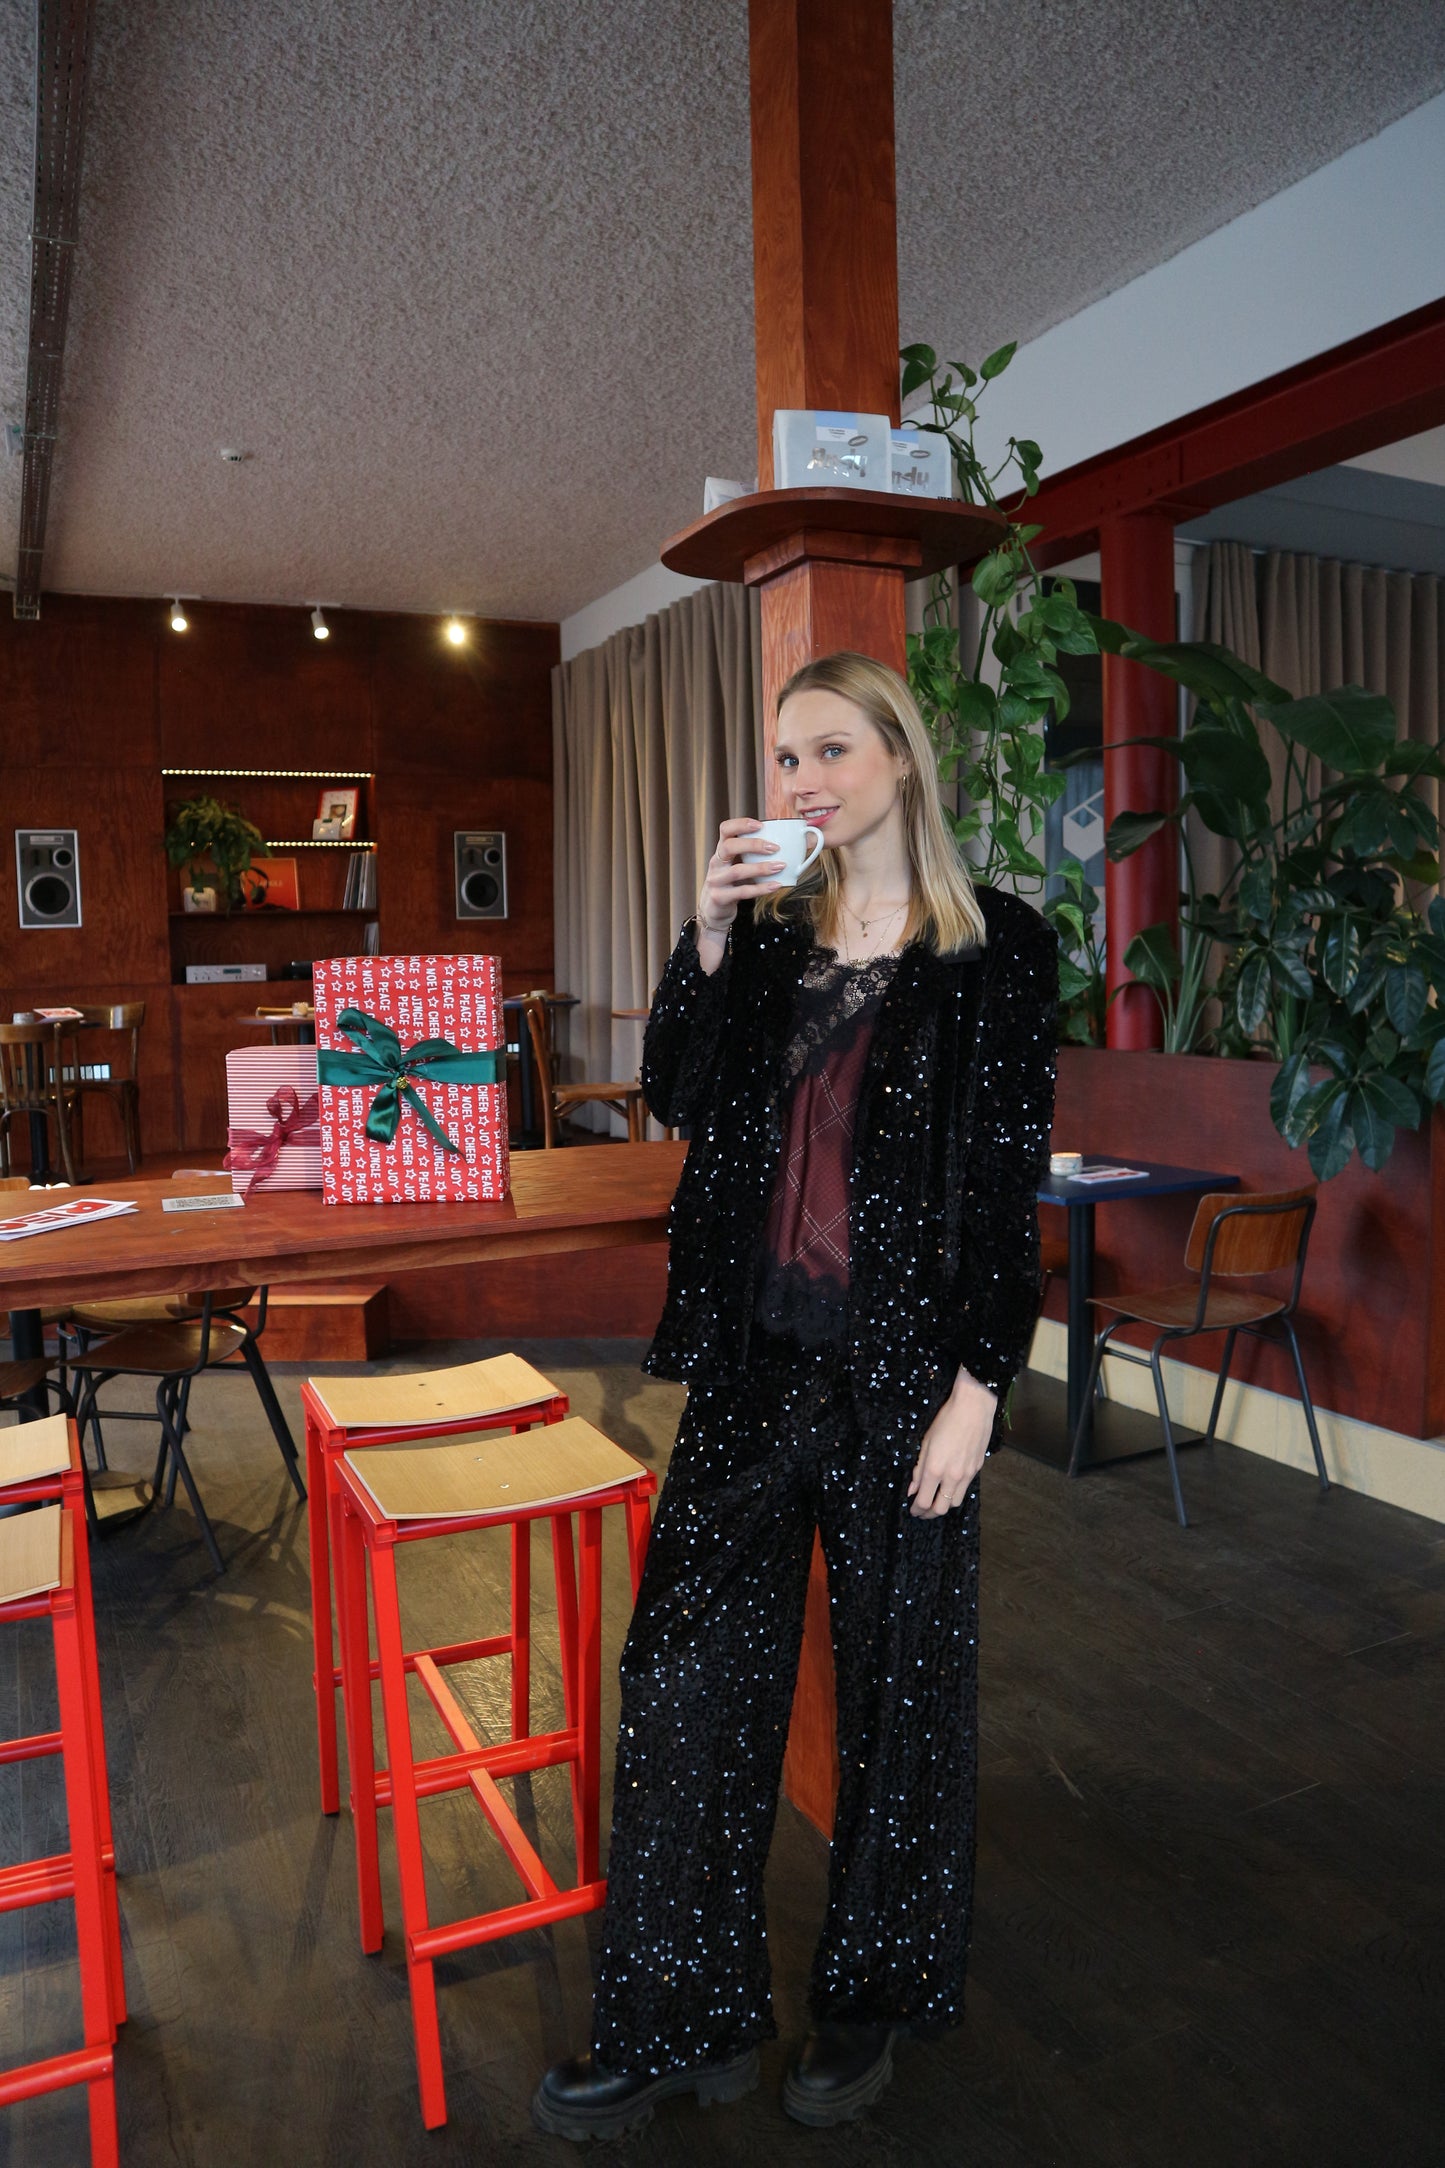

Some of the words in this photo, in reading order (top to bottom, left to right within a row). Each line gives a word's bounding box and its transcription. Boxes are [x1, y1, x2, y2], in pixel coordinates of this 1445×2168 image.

[362, 970, 374, 995] NOEL
[425, 968, 438, 993] NOEL
[442, 979, 455, 1009] PEACE
[314, 983, 327, 1013] PEACE
[378, 981, 391, 1011] PEACE
[397, 995, 411, 1025] PEACE
[459, 993, 472, 1023] PEACE
[474, 993, 487, 1025] JINGLE
[411, 995, 424, 1027] JINGLE
[428, 1010, 440, 1039] CHEER
[338, 1099, 350, 1124] NOEL
[351, 1088, 363, 1116] CHEER
[461, 1095, 473, 1120] NOEL
[477, 1085, 489, 1113] CHEER
[321, 1125, 333, 1153] CHEER
[353, 1132, 365, 1152] JOY
[401, 1138, 414, 1166] CHEER
[416, 1130, 427, 1150] JOY
[464, 1136, 476, 1164] CHEER
[479, 1128, 491, 1149] JOY
[338, 1140, 351, 1168] CHEER
[369, 1146, 381, 1179] JINGLE
[433, 1144, 445, 1177] JINGLE
[324, 1171, 336, 1190] JOY
[355, 1172, 368, 1202] PEACE
[387, 1169, 399, 1189] JOY
[418, 1171, 431, 1200] PEACE
[450, 1167, 462, 1187] JOY
[467, 1181, 479, 1201] JOY
[481, 1169, 494, 1199] PEACE
[341, 1184, 353, 1203] JOY
[404, 1182, 416, 1202] JOY
